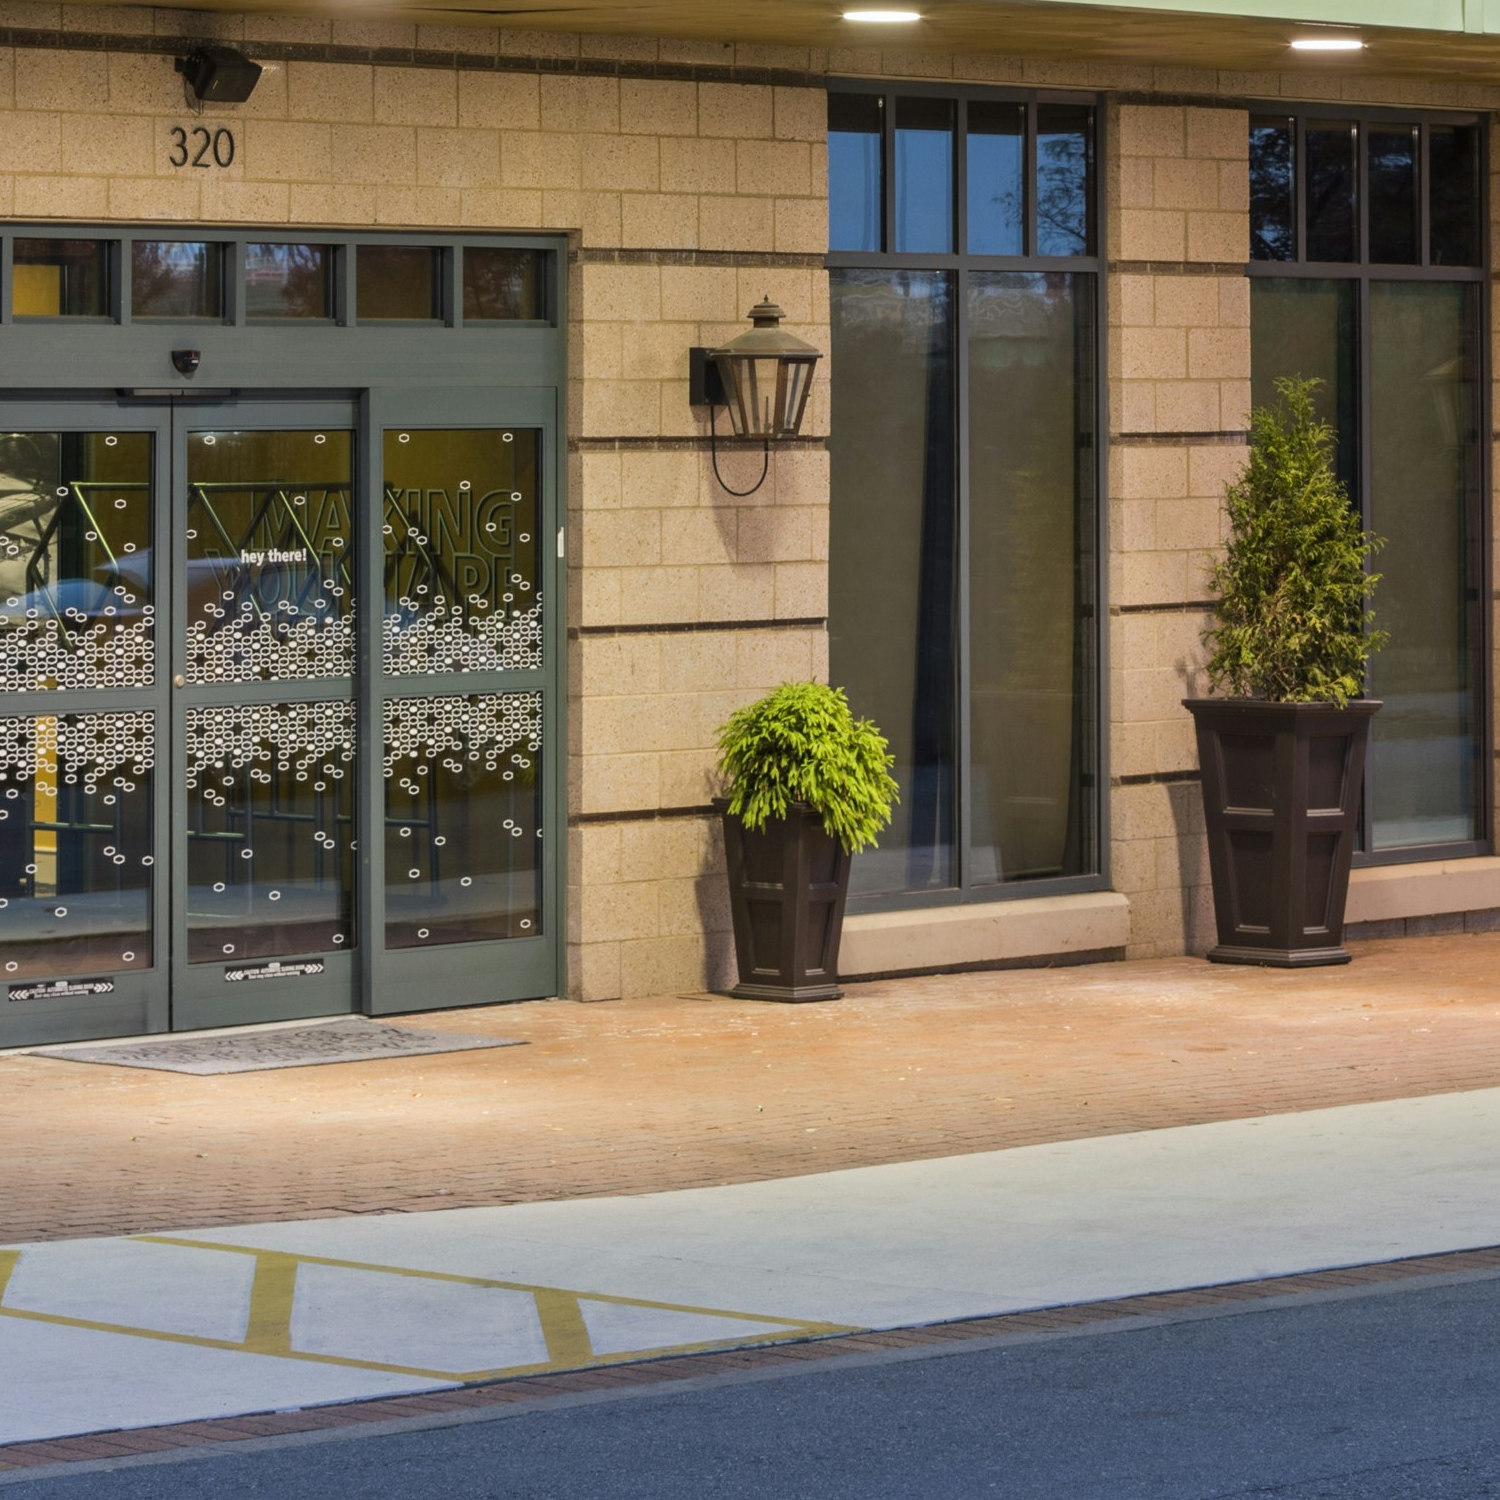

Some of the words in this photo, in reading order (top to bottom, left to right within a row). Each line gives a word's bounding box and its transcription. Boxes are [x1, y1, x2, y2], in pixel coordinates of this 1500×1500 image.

[169, 126, 235, 168] 320
[240, 548, 265, 566] hey
[268, 547, 307, 562] there!
